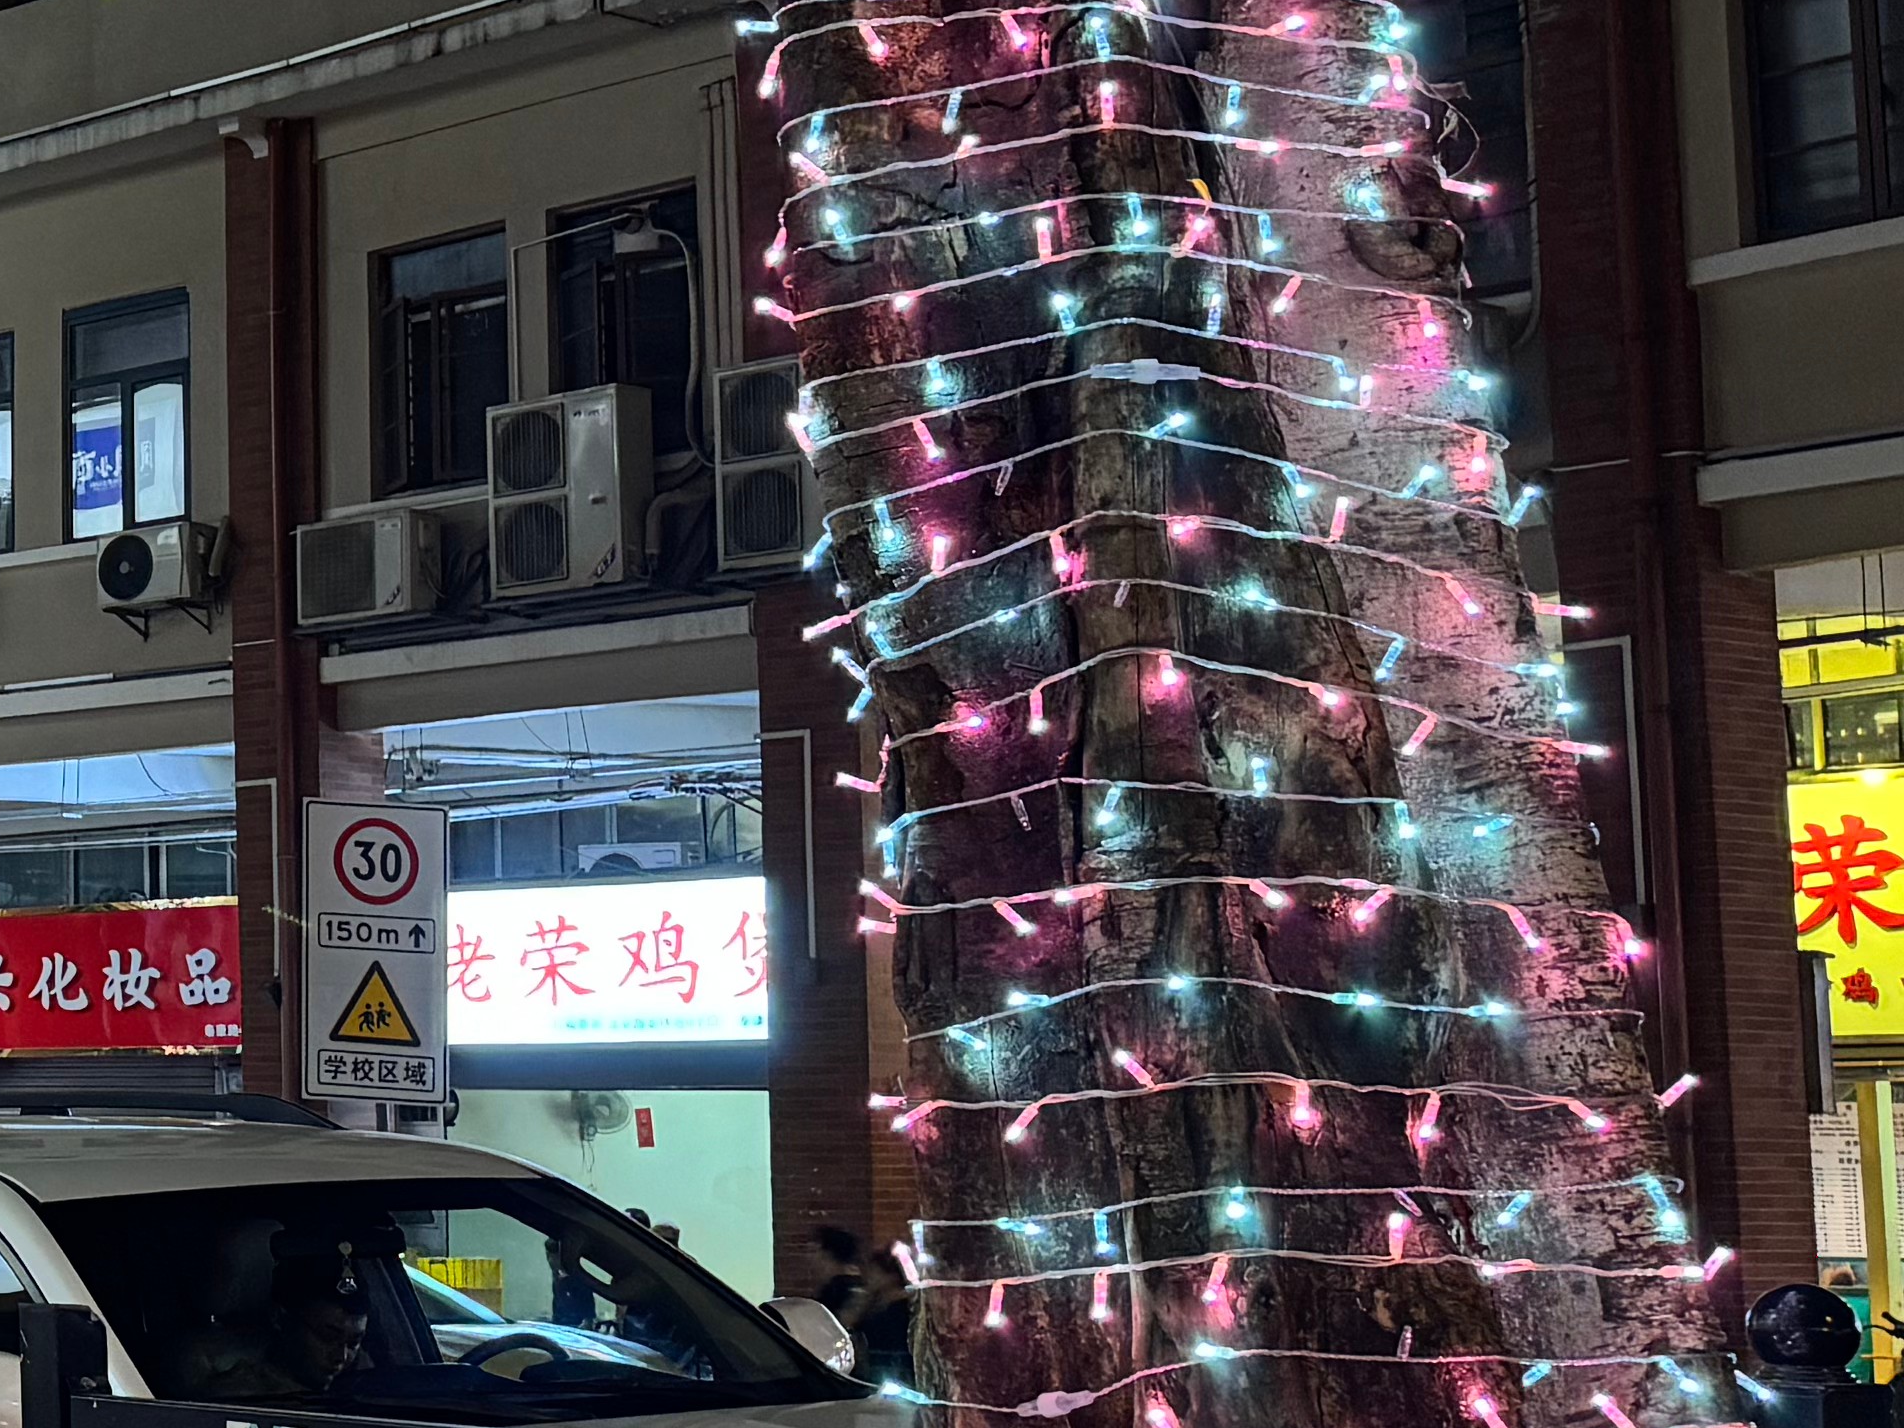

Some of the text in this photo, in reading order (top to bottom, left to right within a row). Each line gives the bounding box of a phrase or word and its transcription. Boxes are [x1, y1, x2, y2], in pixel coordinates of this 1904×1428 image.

[352, 840, 402, 883] 30
[1792, 814, 1904, 948] 荣
[326, 920, 399, 945] 150m
[323, 1055, 428, 1087] 学校区域
